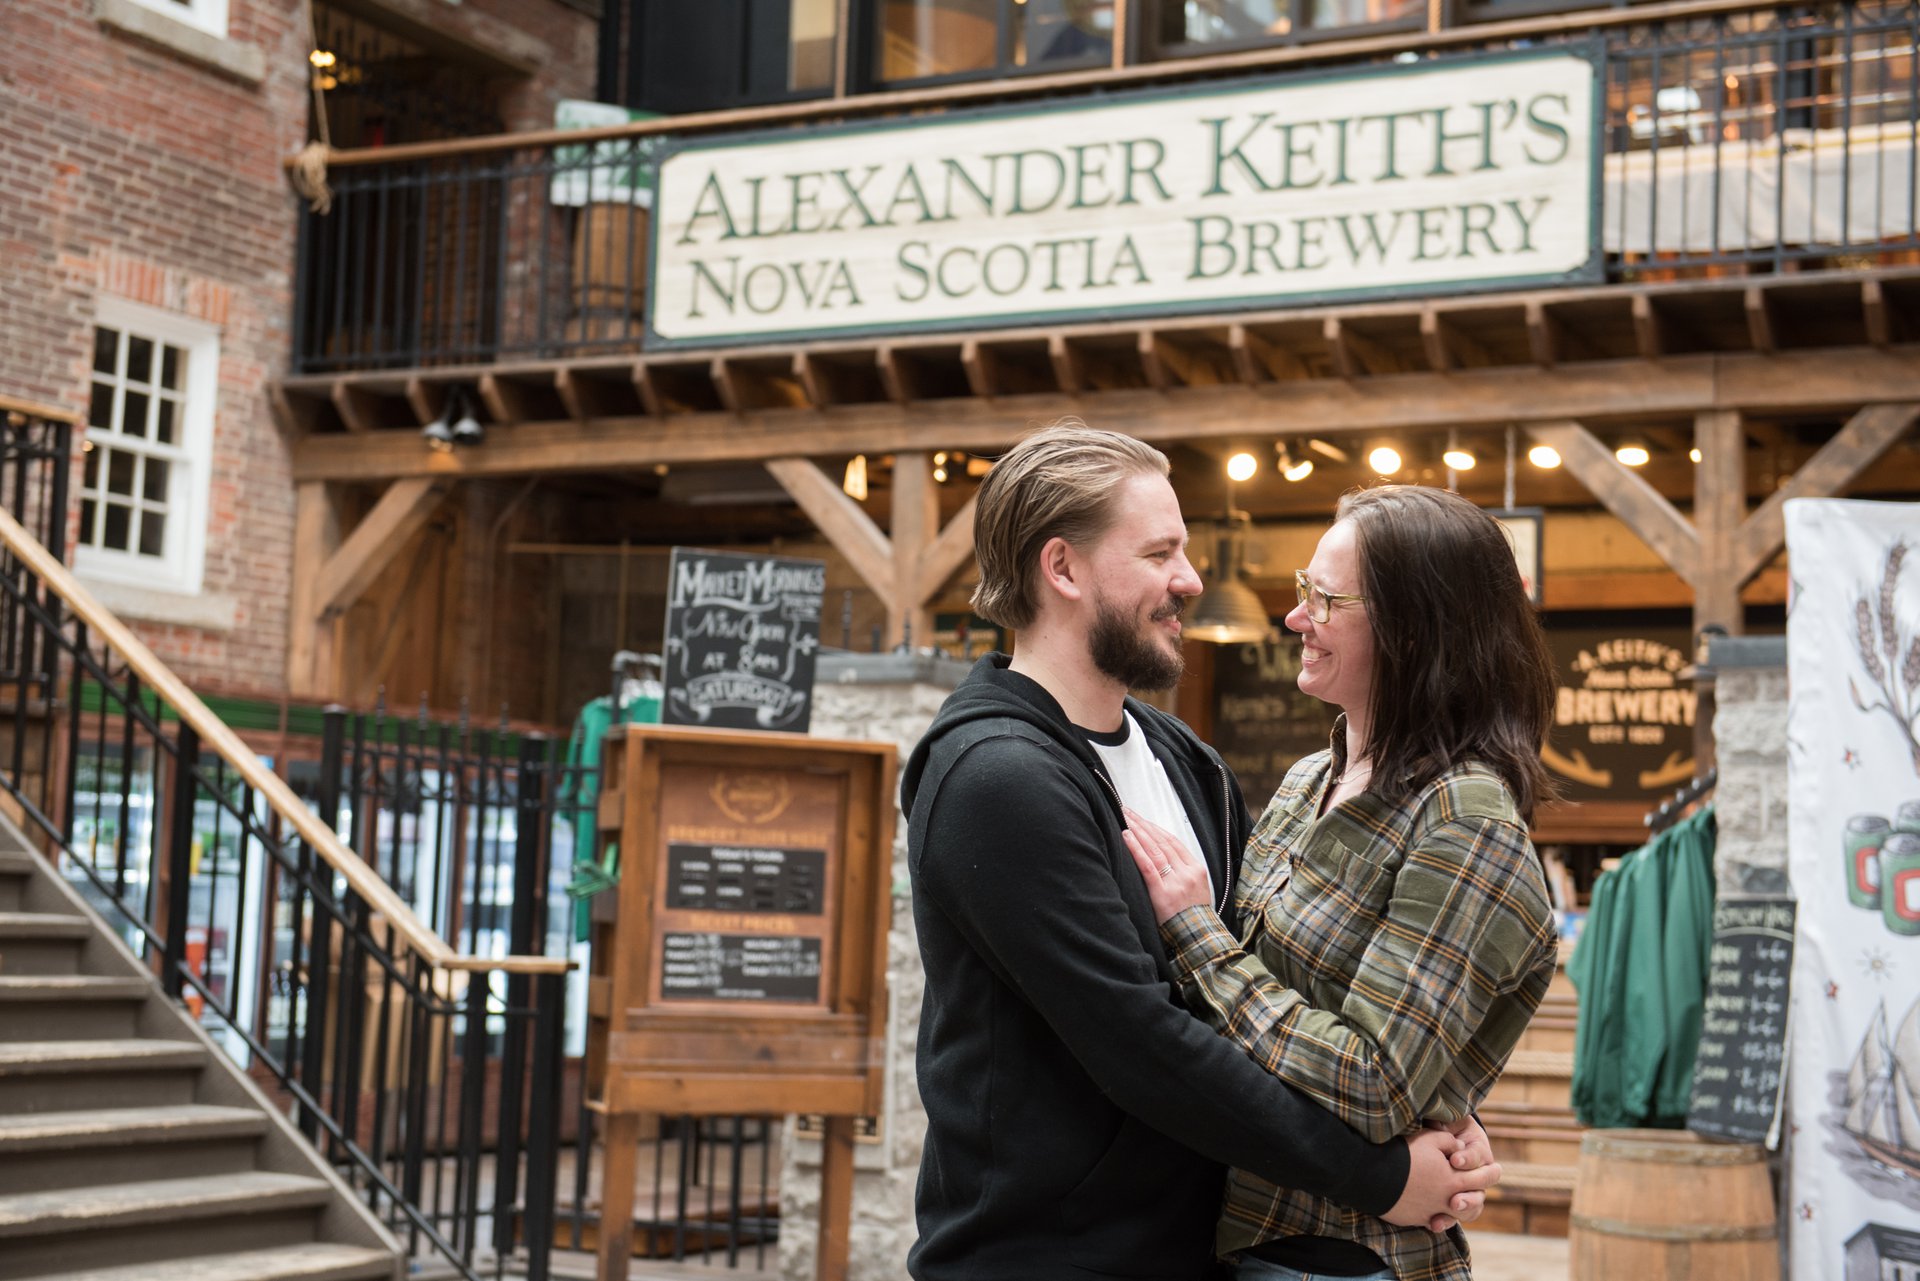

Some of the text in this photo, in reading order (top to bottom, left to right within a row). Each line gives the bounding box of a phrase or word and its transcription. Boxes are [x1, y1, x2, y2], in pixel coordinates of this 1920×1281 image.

[676, 93, 1571, 246] ALEXANDER KEITH'S
[687, 196, 1551, 319] NOVA SCOTIA BREWERY
[1556, 687, 1698, 727] BREWERY
